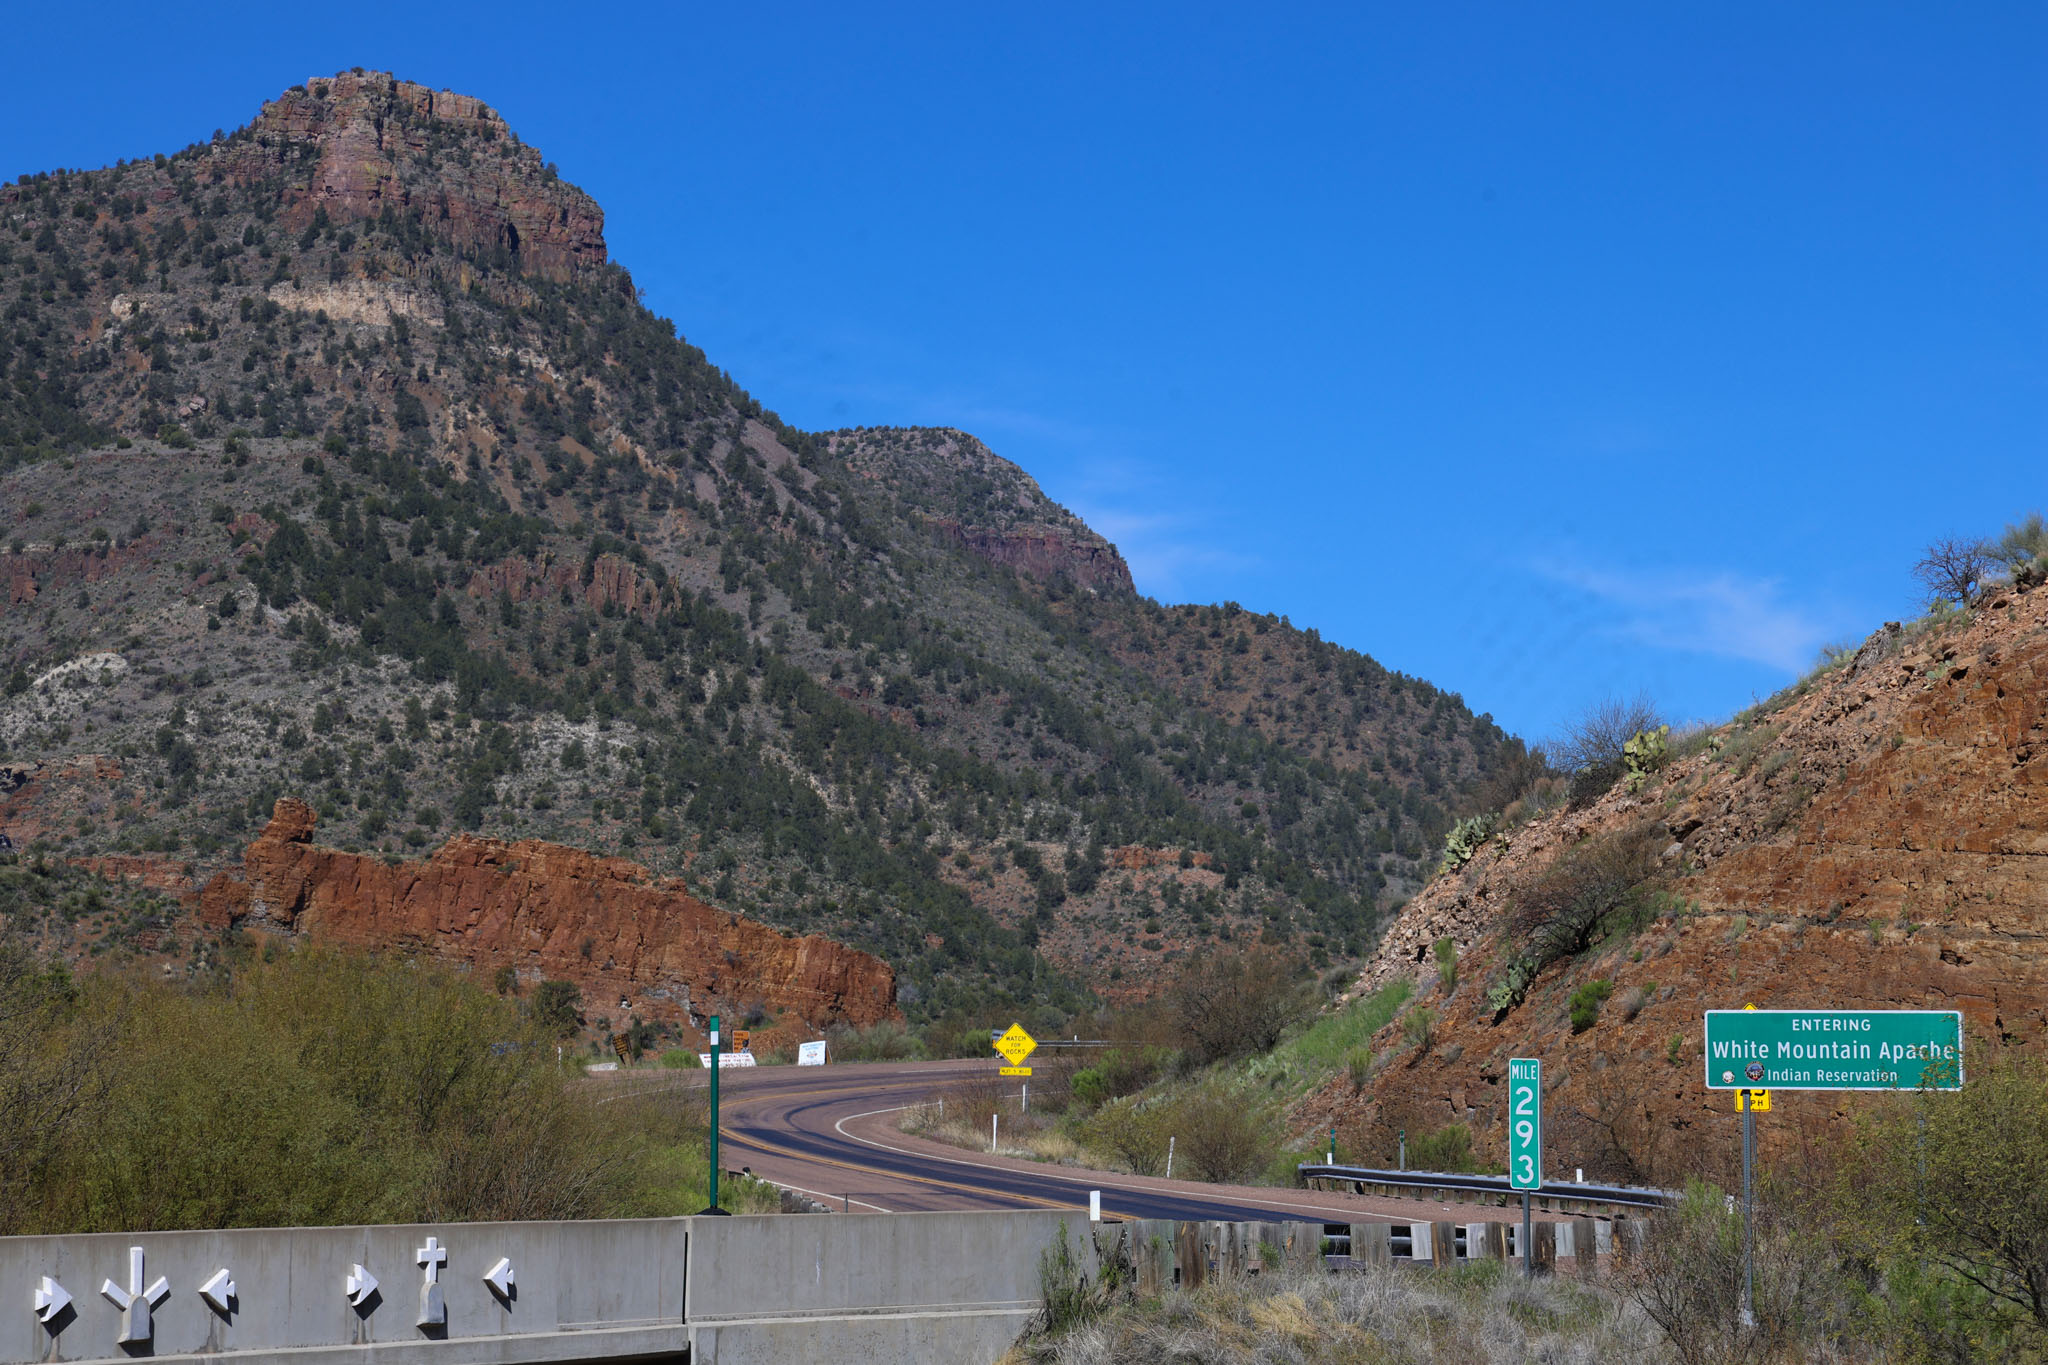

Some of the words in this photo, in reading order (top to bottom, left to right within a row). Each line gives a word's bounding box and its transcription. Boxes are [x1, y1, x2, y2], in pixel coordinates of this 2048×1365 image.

[1792, 1019, 1871, 1031] ENTERING
[1713, 1040, 1769, 1059] White
[1777, 1041, 1871, 1059] Mountain
[1879, 1041, 1955, 1063] Apache
[1512, 1065, 1536, 1080] MILE
[1767, 1069, 1810, 1081] Indian
[1817, 1069, 1898, 1082] Reservation
[1515, 1086, 1534, 1184] 293
